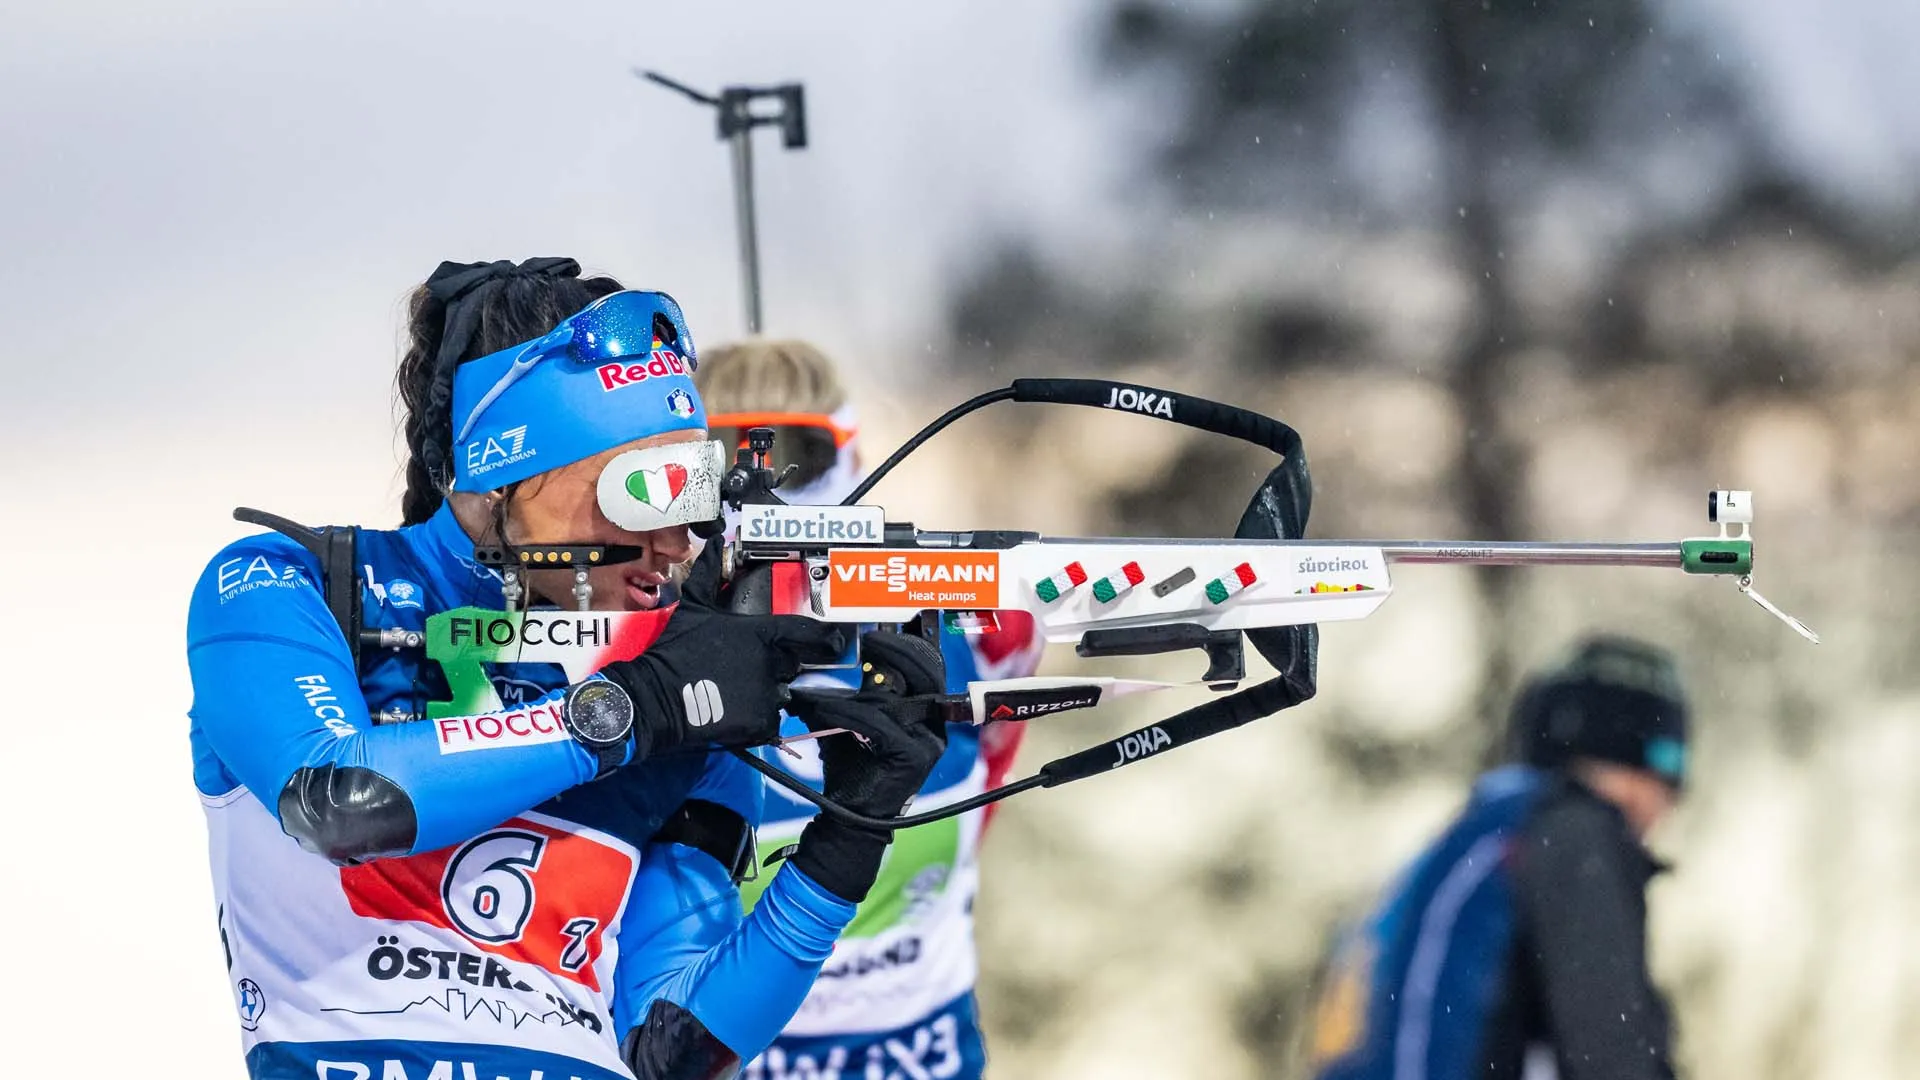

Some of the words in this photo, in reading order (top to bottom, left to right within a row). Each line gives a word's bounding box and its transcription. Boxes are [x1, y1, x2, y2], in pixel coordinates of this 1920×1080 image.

[597, 351, 669, 392] Red
[1103, 387, 1173, 418] JOKA
[468, 425, 527, 469] EA7
[834, 556, 995, 593] VIESSMANN
[908, 591, 935, 602] Heat
[938, 591, 977, 604] pumps
[450, 617, 611, 647] FIOCCHI
[439, 704, 565, 744] FIOCCH
[1016, 697, 1092, 716] RIZZOLI
[1112, 726, 1172, 769] JOKA
[441, 829, 548, 945] 6
